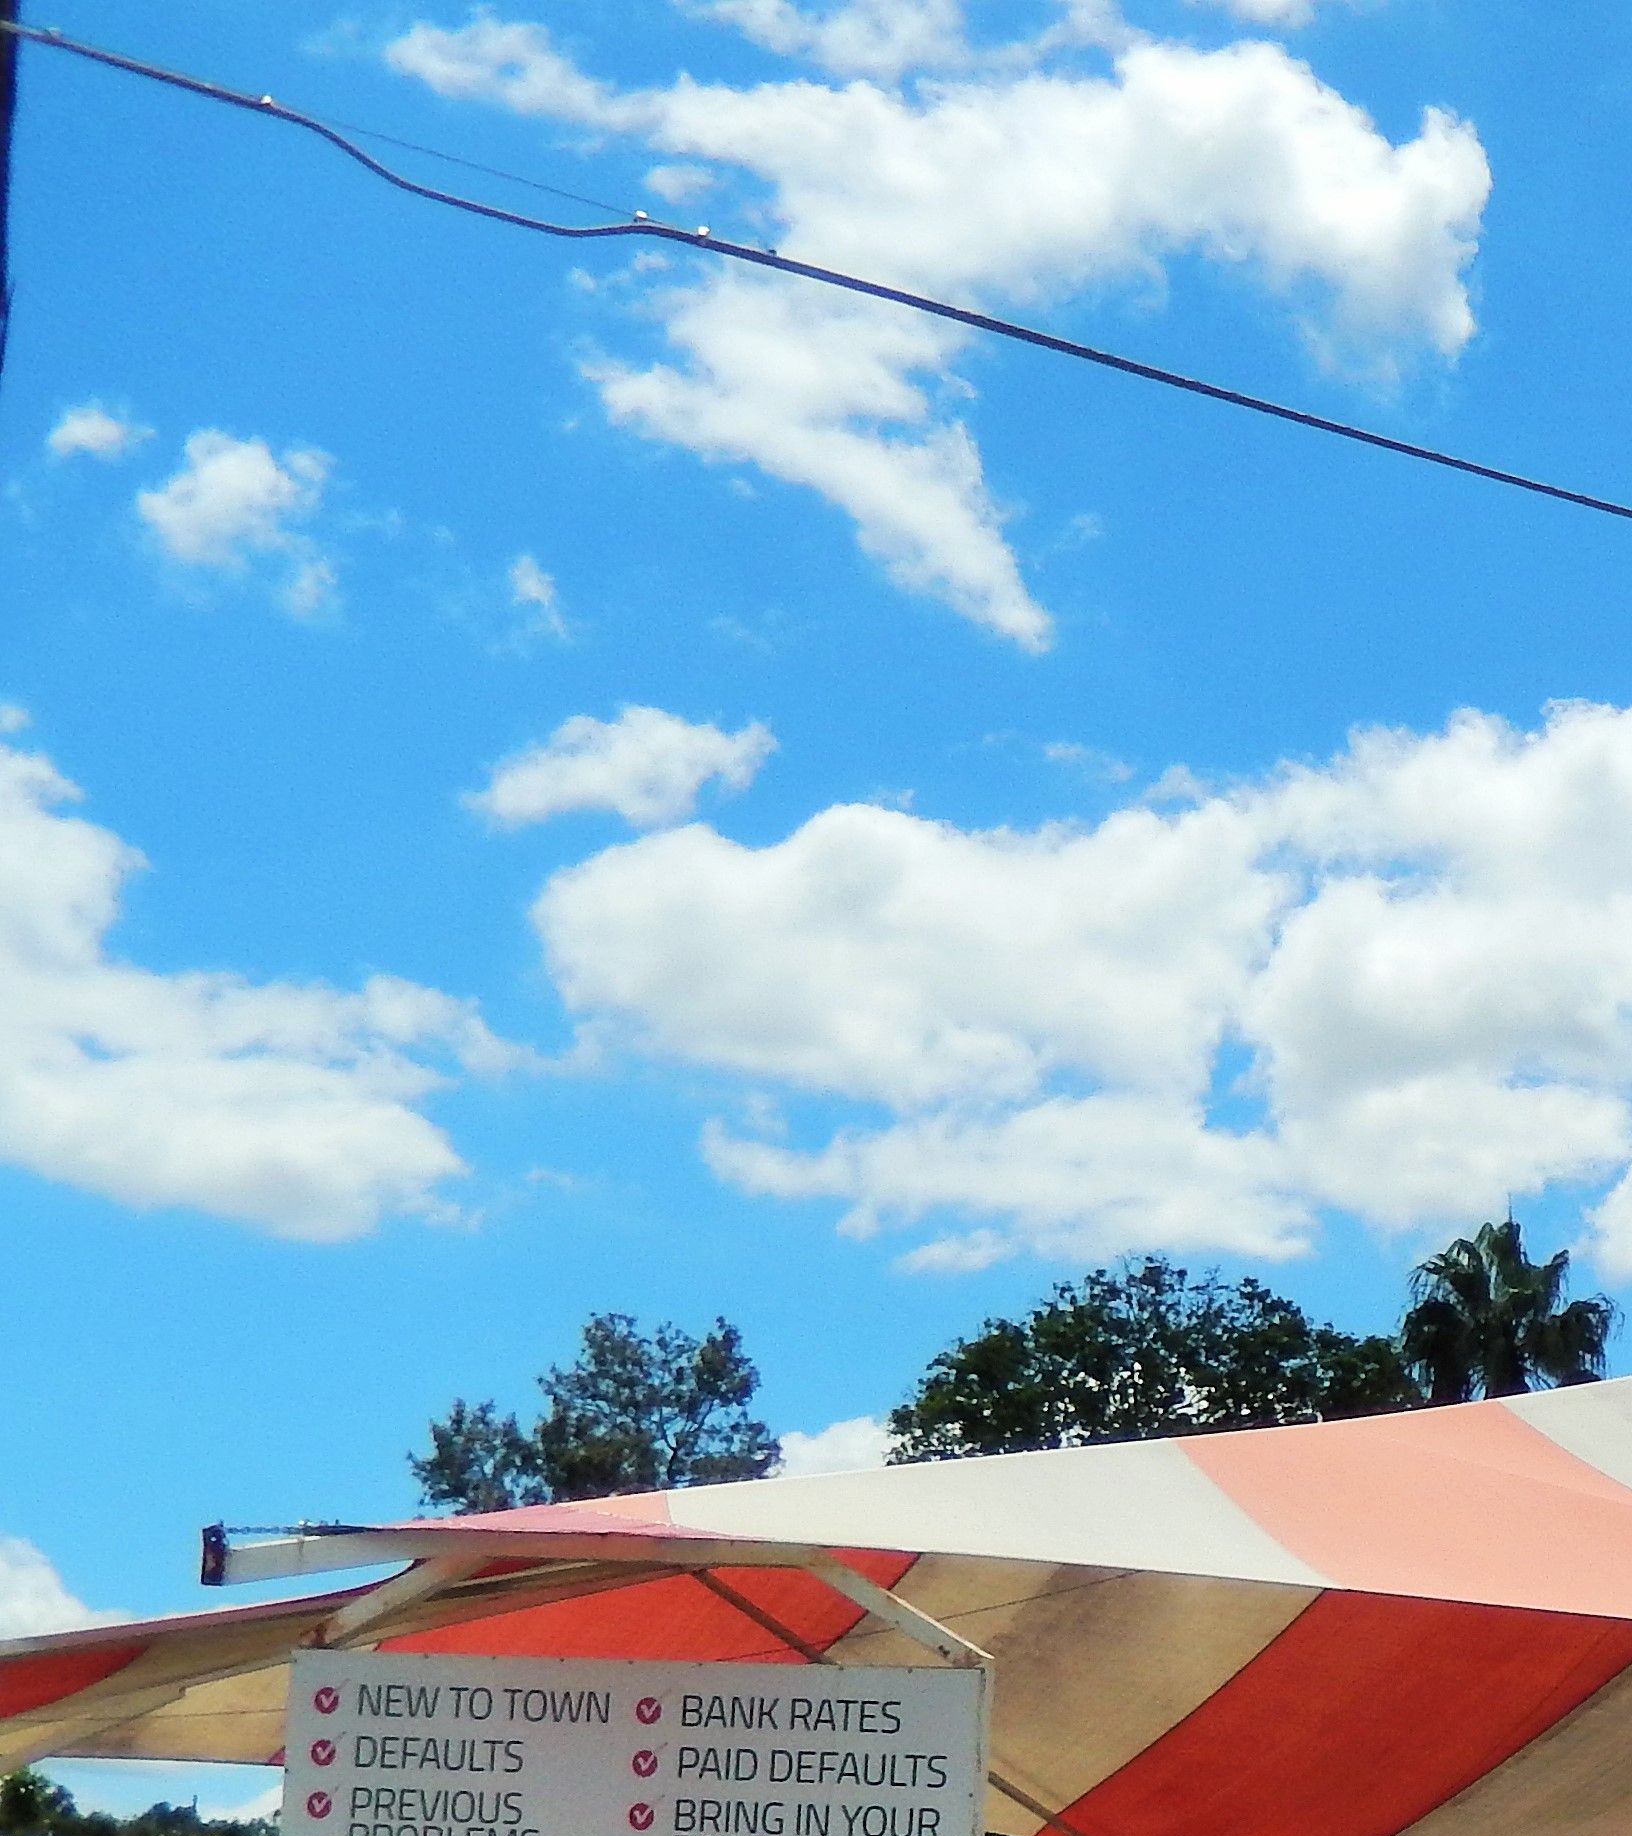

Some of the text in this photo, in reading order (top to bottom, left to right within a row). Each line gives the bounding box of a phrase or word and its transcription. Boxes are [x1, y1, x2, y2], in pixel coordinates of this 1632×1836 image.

[357, 1684, 612, 1725] NEW TO TOWN
[680, 1694, 902, 1735] BANK RATES
[354, 1735, 525, 1774] DEFAULTS
[677, 1745, 949, 1789] PAID DEFAULTS
[349, 1787, 524, 1826] PREVIOUS
[672, 1798, 785, 1836] BRING
